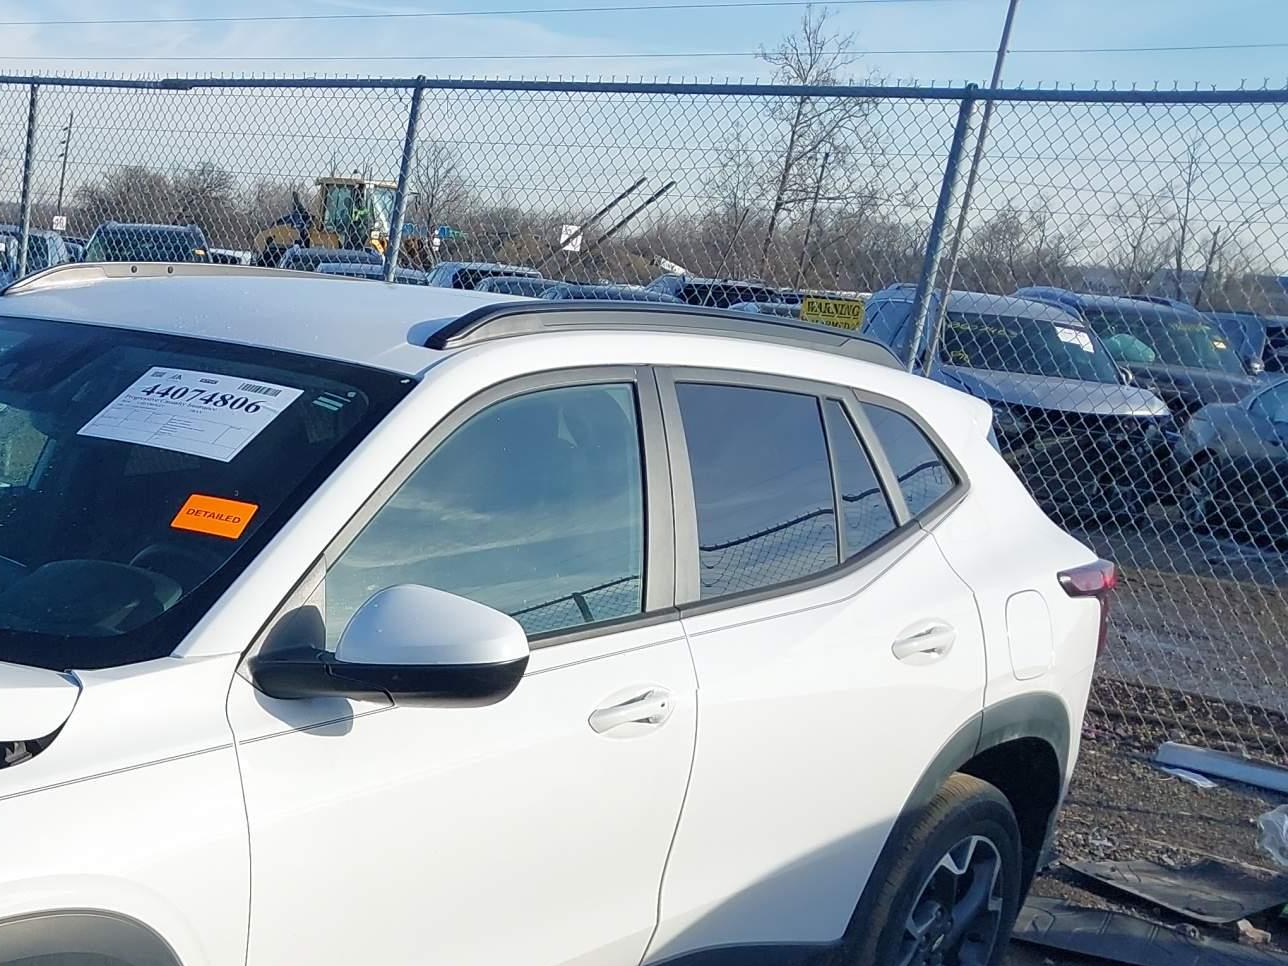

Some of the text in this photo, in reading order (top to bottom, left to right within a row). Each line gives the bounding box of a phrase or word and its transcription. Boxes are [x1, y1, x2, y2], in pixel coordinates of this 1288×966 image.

[807, 301, 861, 317] WARNING
[140, 383, 267, 414] 44074806
[186, 508, 241, 524] DETAILED
